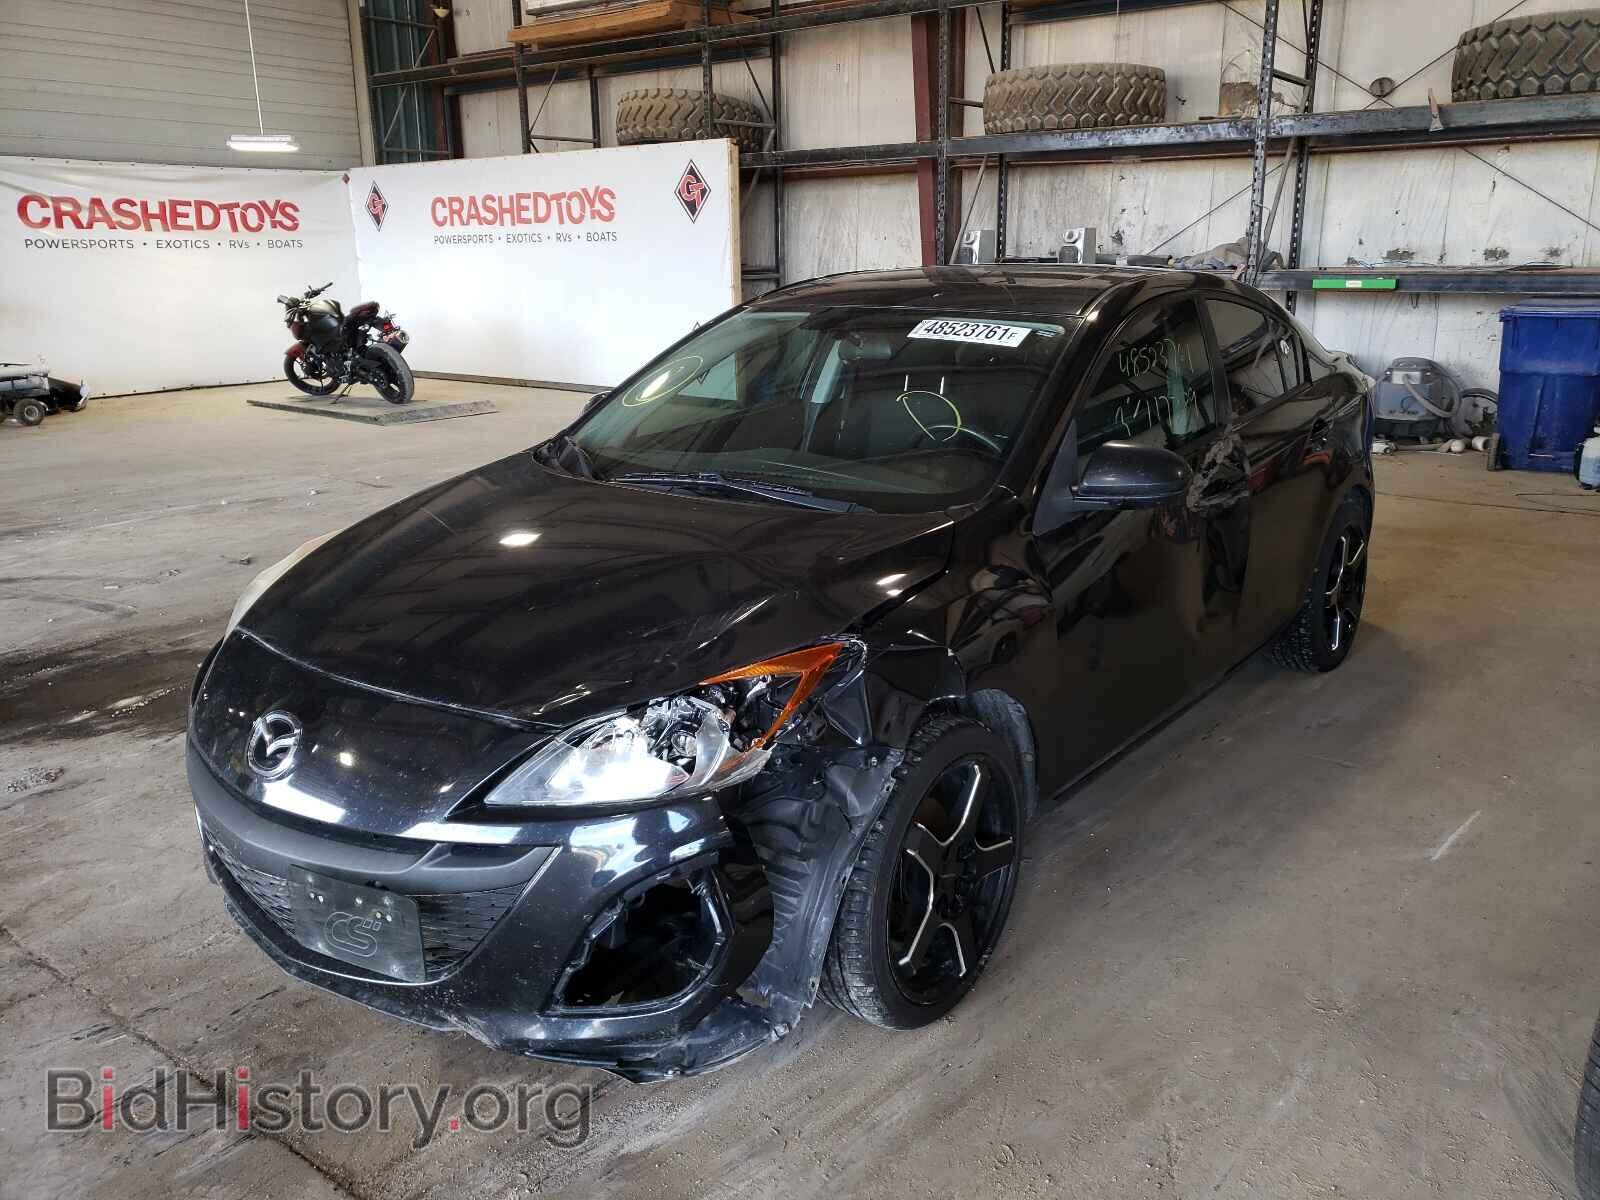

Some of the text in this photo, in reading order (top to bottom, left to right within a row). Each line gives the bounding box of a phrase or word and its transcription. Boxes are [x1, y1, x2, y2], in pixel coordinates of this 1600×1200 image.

[17, 194, 300, 233] CRASHEDTOYS
[431, 185, 616, 228] CRASHEDTOYS
[24, 238, 304, 249] POWERSPORTS EXOTICS RVs BOATS
[433, 231, 618, 245] POWERSPORTS EXOTICS RVs BOATS
